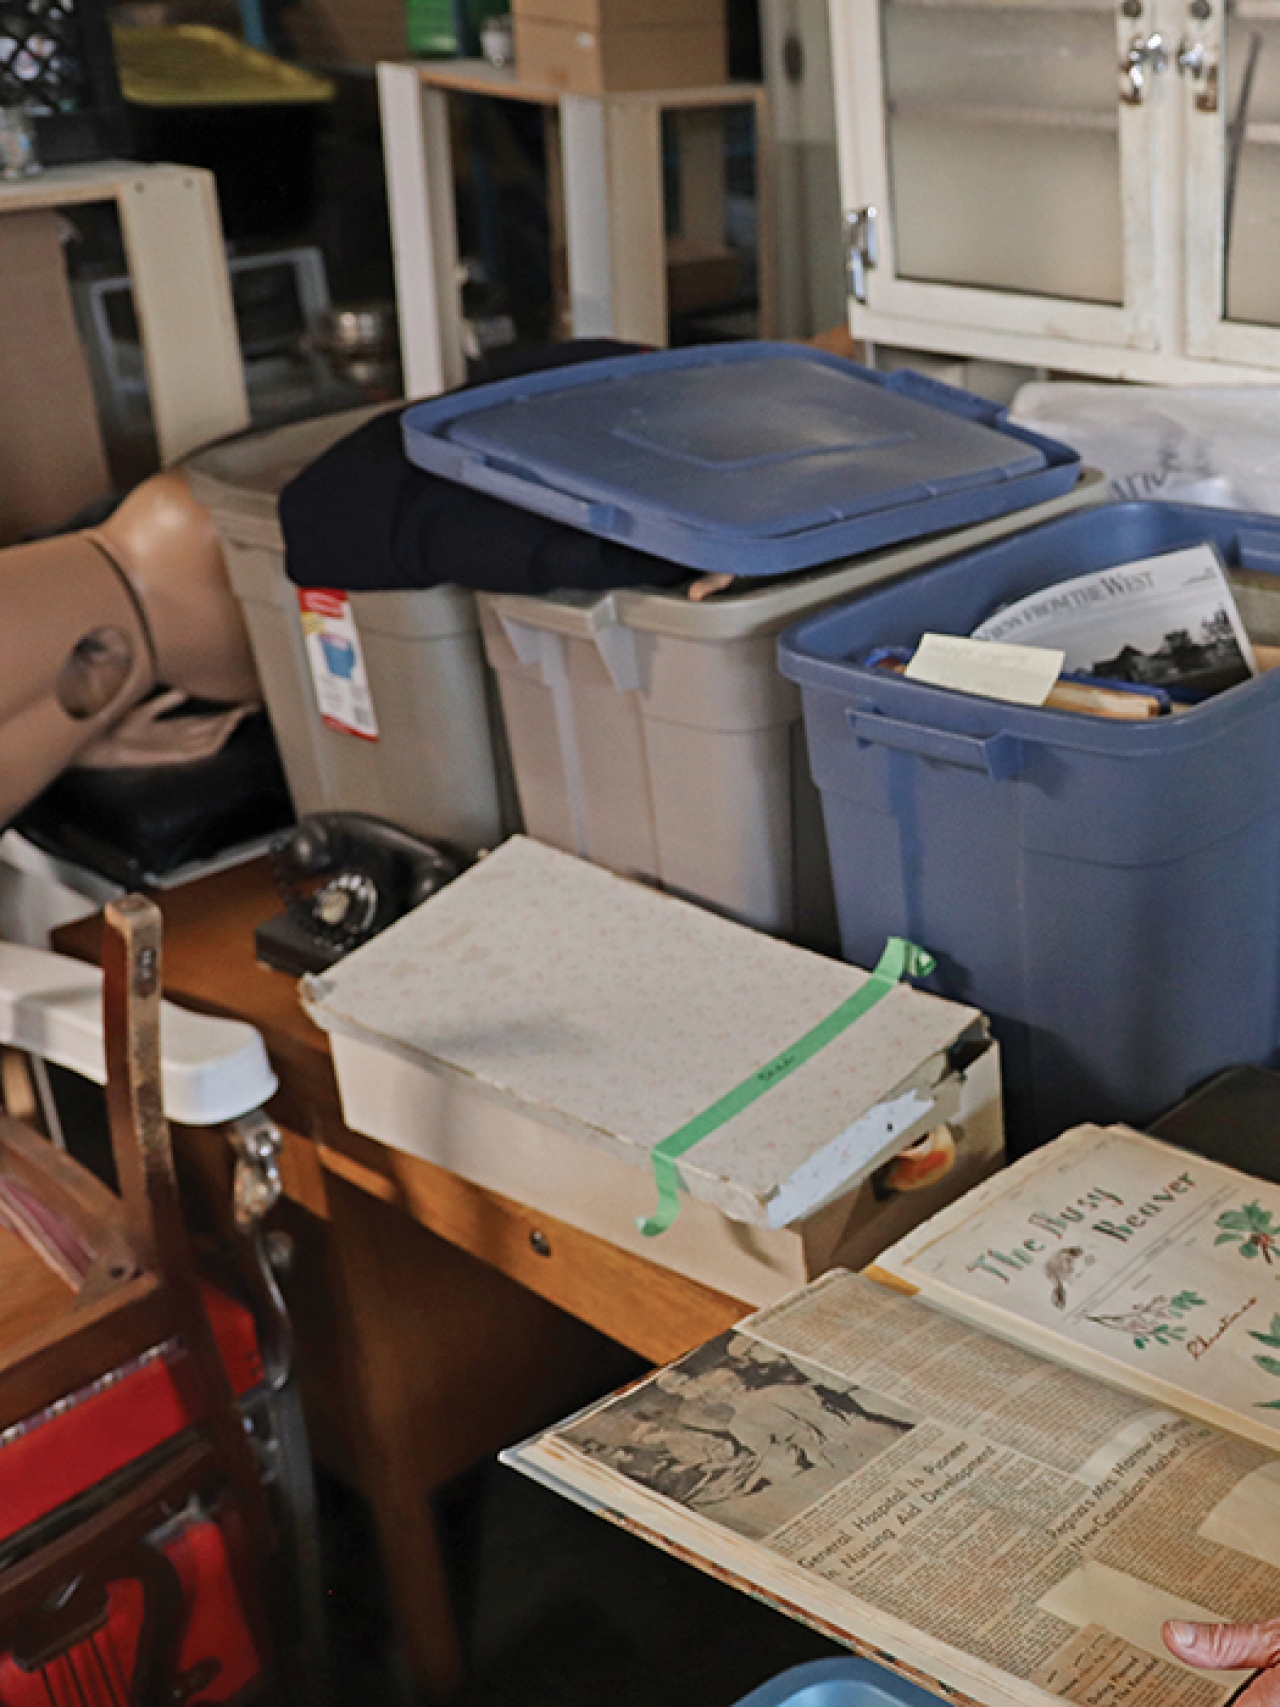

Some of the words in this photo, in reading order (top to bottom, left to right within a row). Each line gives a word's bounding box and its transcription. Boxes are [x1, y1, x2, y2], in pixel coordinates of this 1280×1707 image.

[965, 1237, 1046, 1283] The
[1028, 1186, 1125, 1240] Busy
[1092, 1172, 1195, 1243] Beaver
[920, 1445, 996, 1504] Development
[797, 1530, 853, 1570] General
[853, 1487, 908, 1531] Hospital
